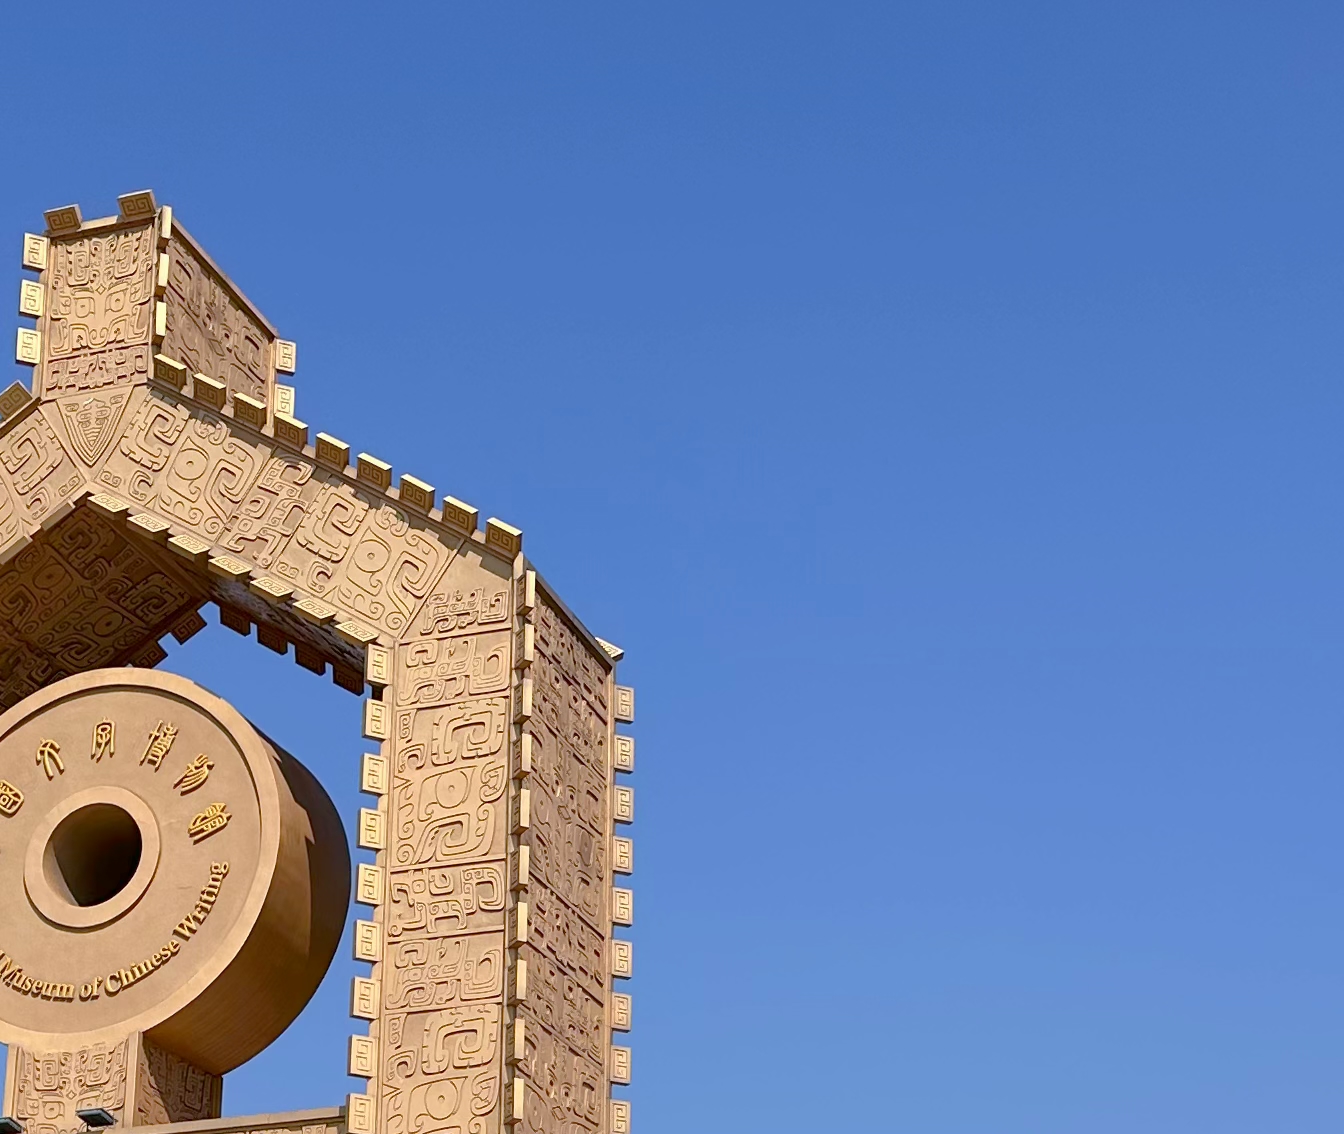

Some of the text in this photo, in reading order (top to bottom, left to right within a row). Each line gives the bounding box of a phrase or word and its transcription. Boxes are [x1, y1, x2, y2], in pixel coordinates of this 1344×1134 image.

[78, 975, 105, 1001] of
[104, 938, 181, 997] Chinese
[174, 860, 231, 941] Writing
